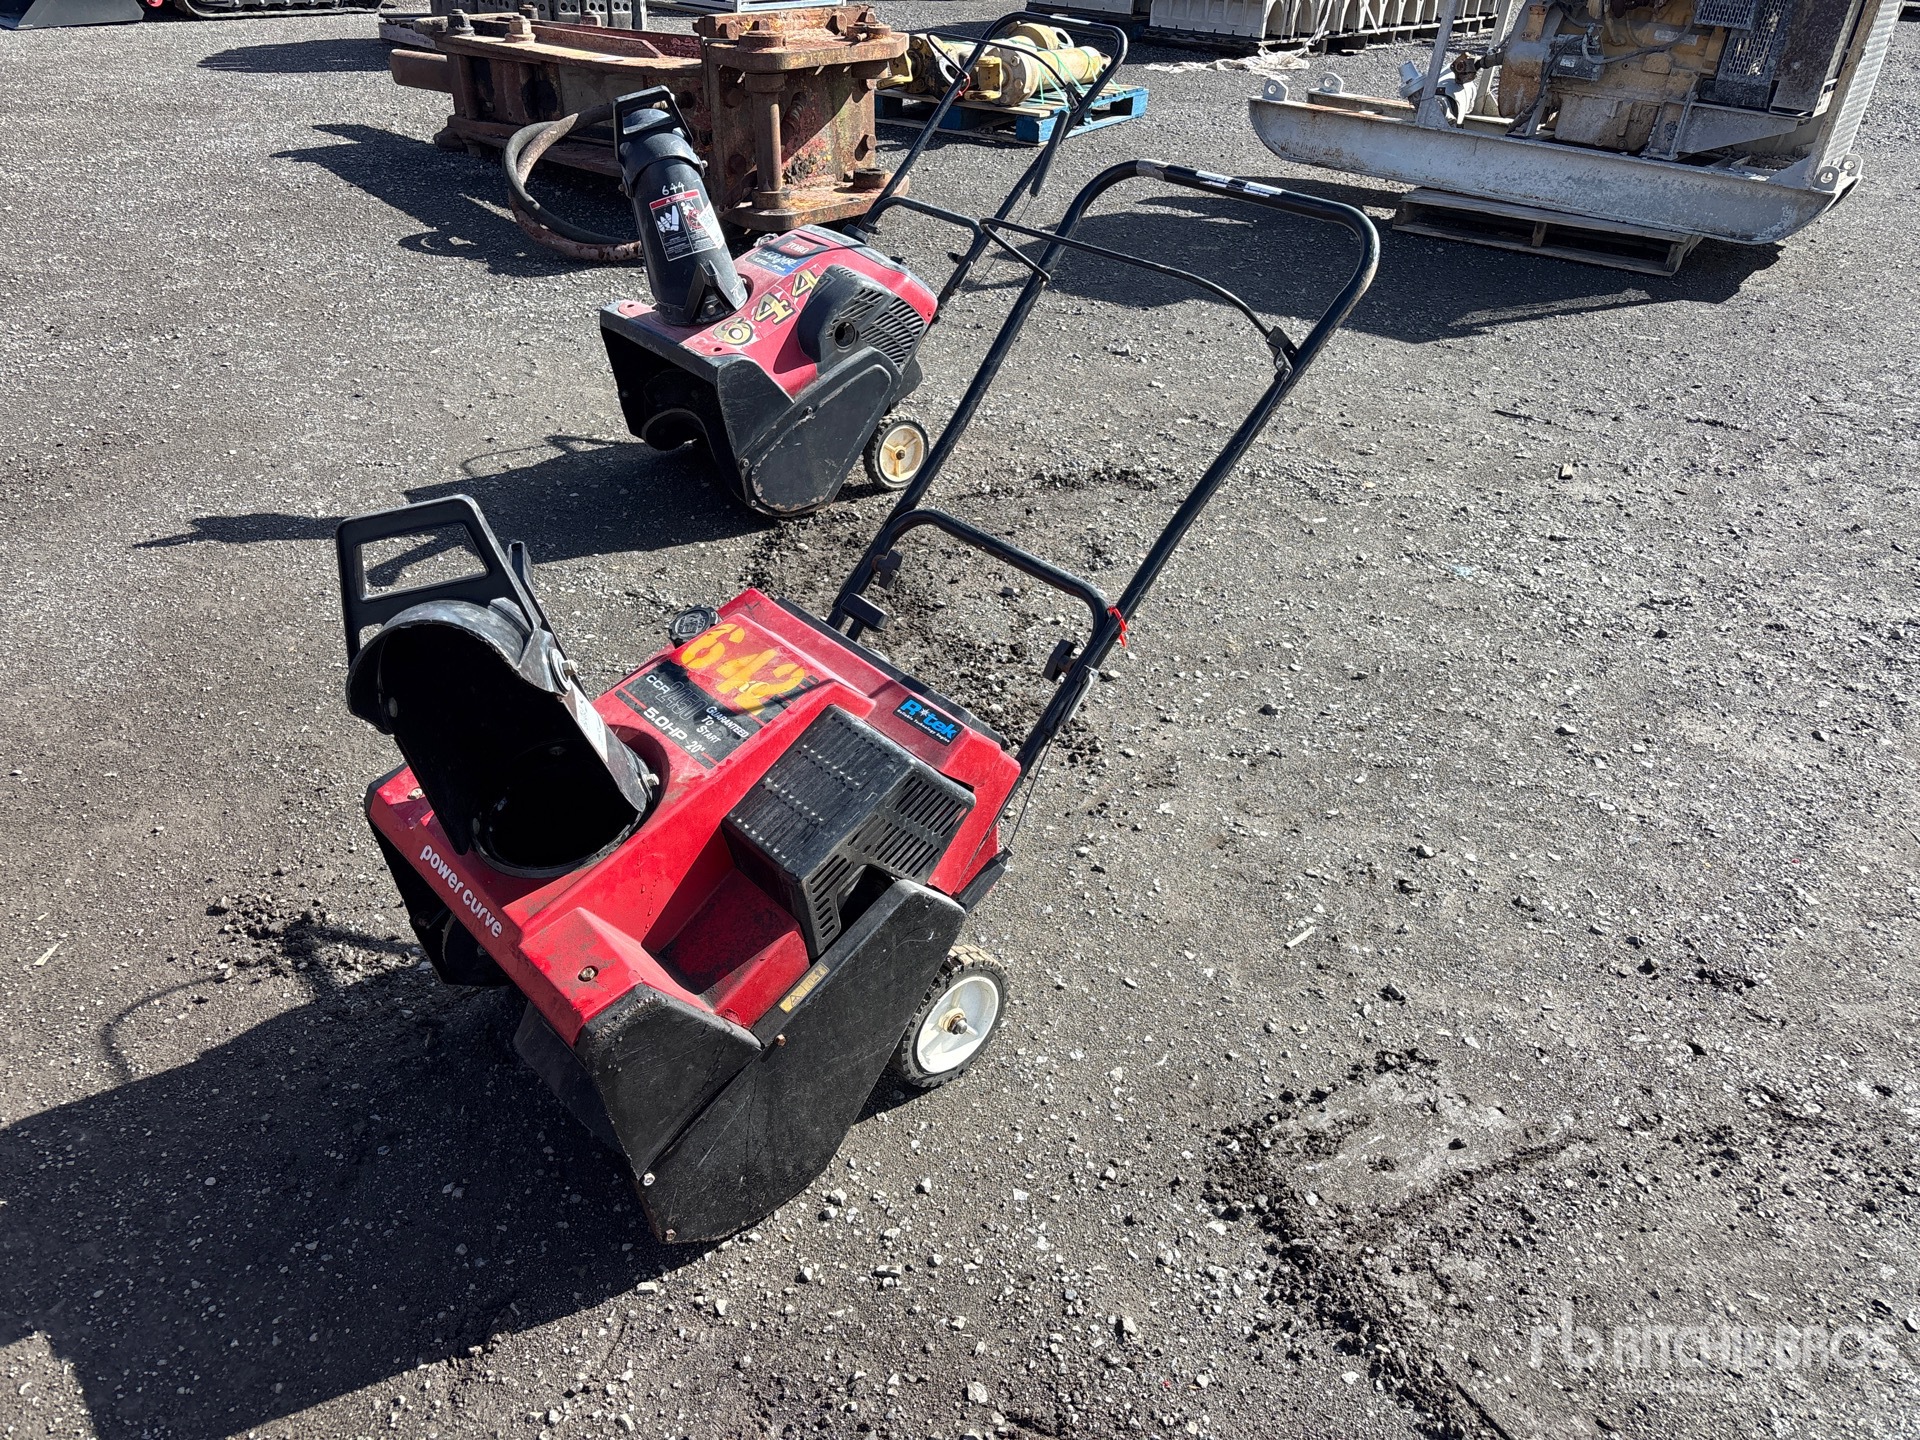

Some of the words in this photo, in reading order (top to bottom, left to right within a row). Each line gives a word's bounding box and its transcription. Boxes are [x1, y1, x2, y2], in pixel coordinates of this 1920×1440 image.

[661, 181, 685, 196] 644
[713, 268, 829, 346] 644
[646, 674, 671, 694] CCR
[681, 623, 805, 715] 642
[655, 681, 708, 720] 2450
[643, 707, 687, 740] 5.0HP
[696, 726, 721, 743] START
[702, 715, 714, 726] TO
[706, 706, 749, 738] GUARANTEED
[914, 719, 936, 734] Technology
[420, 844, 464, 893] power
[462, 889, 502, 937] curve
